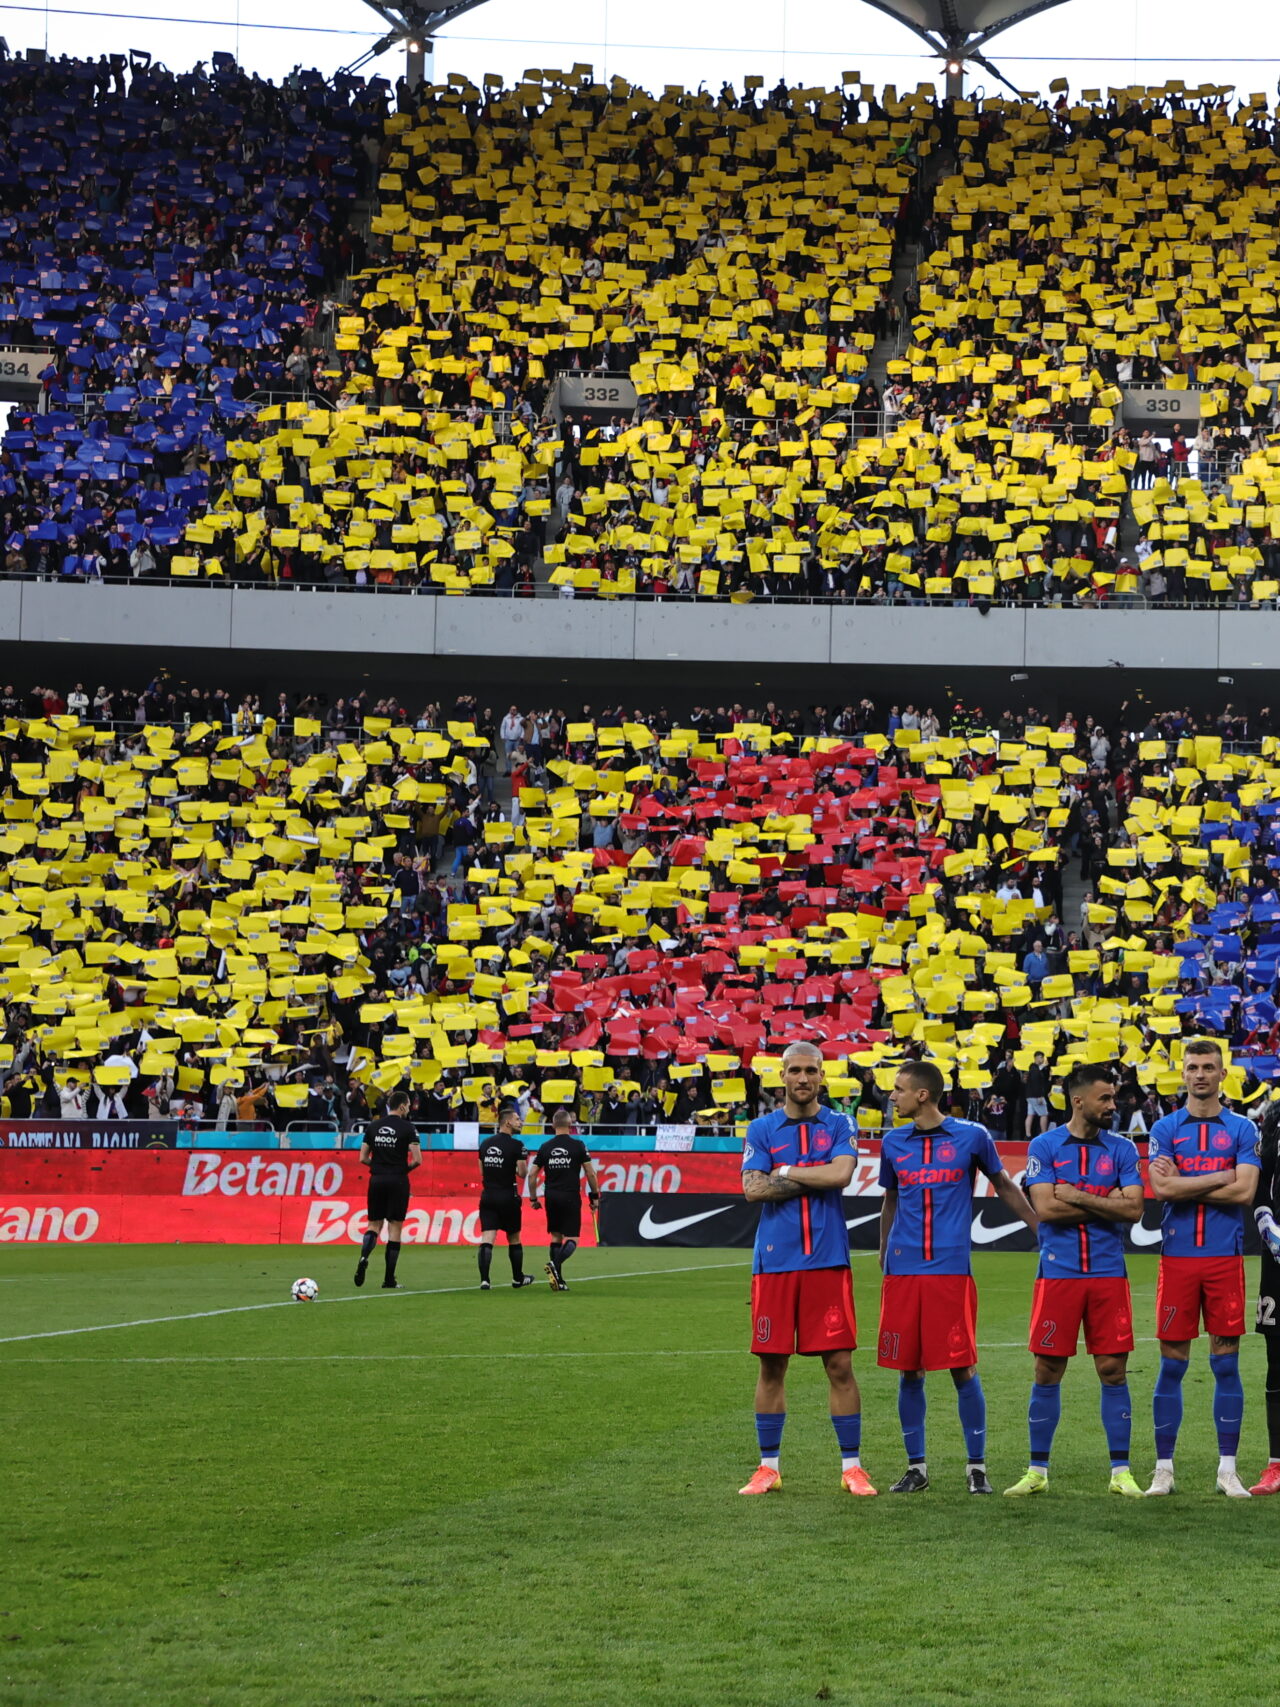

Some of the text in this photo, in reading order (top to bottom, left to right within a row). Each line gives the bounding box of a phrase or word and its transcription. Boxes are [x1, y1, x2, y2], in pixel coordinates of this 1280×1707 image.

[0, 362, 29, 376] 34
[585, 388, 619, 401] 332
[1146, 399, 1181, 412] 330
[375, 1135, 397, 1143] MOOV
[484, 1156, 504, 1164] MOOV
[182, 1153, 343, 1197] Betano
[898, 1168, 964, 1187] Betano
[0, 1206, 99, 1242] ano
[757, 1315, 771, 1342] 9
[1163, 1306, 1177, 1332] 7
[1040, 1319, 1056, 1347] 2
